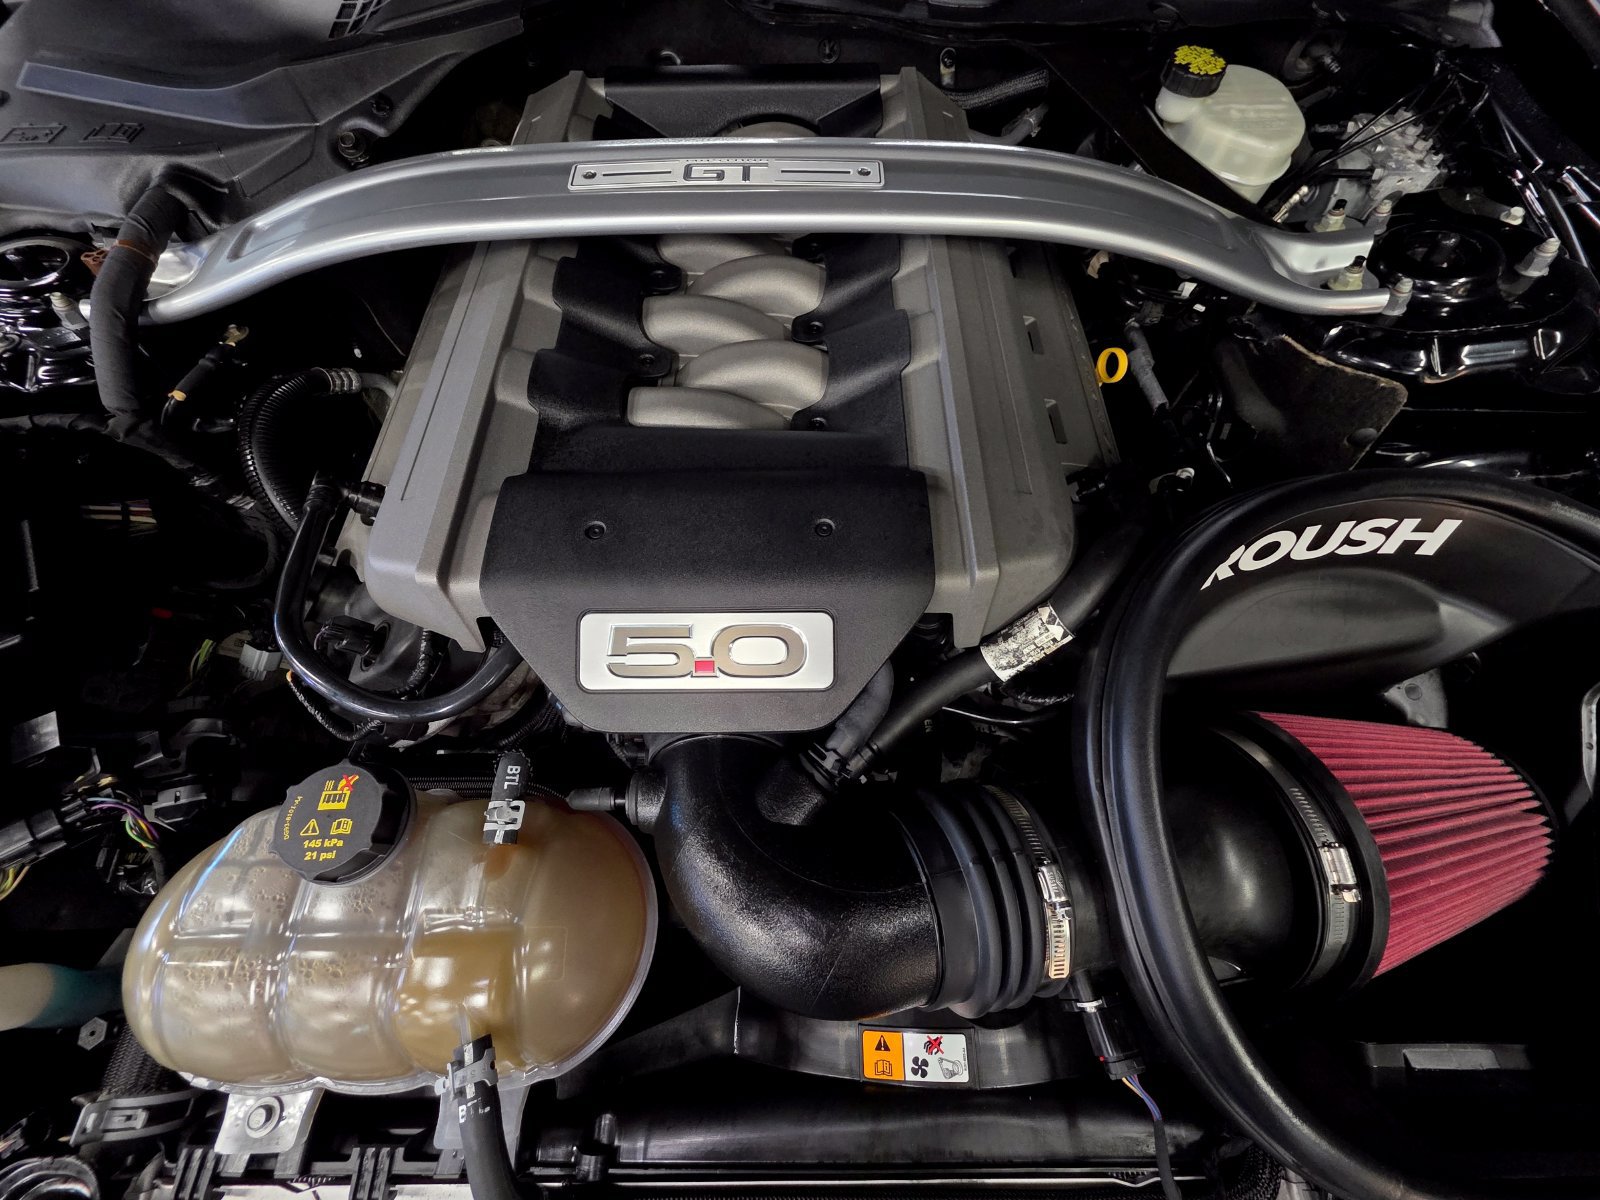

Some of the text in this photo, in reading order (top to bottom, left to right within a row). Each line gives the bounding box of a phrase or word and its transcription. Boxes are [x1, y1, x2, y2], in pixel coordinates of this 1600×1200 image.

[683, 162, 769, 181] GT
[606, 623, 808, 679] 5.0
[503, 765, 521, 790] BTL
[303, 838, 343, 848] 145 kPa
[304, 850, 336, 861] 21 psi
